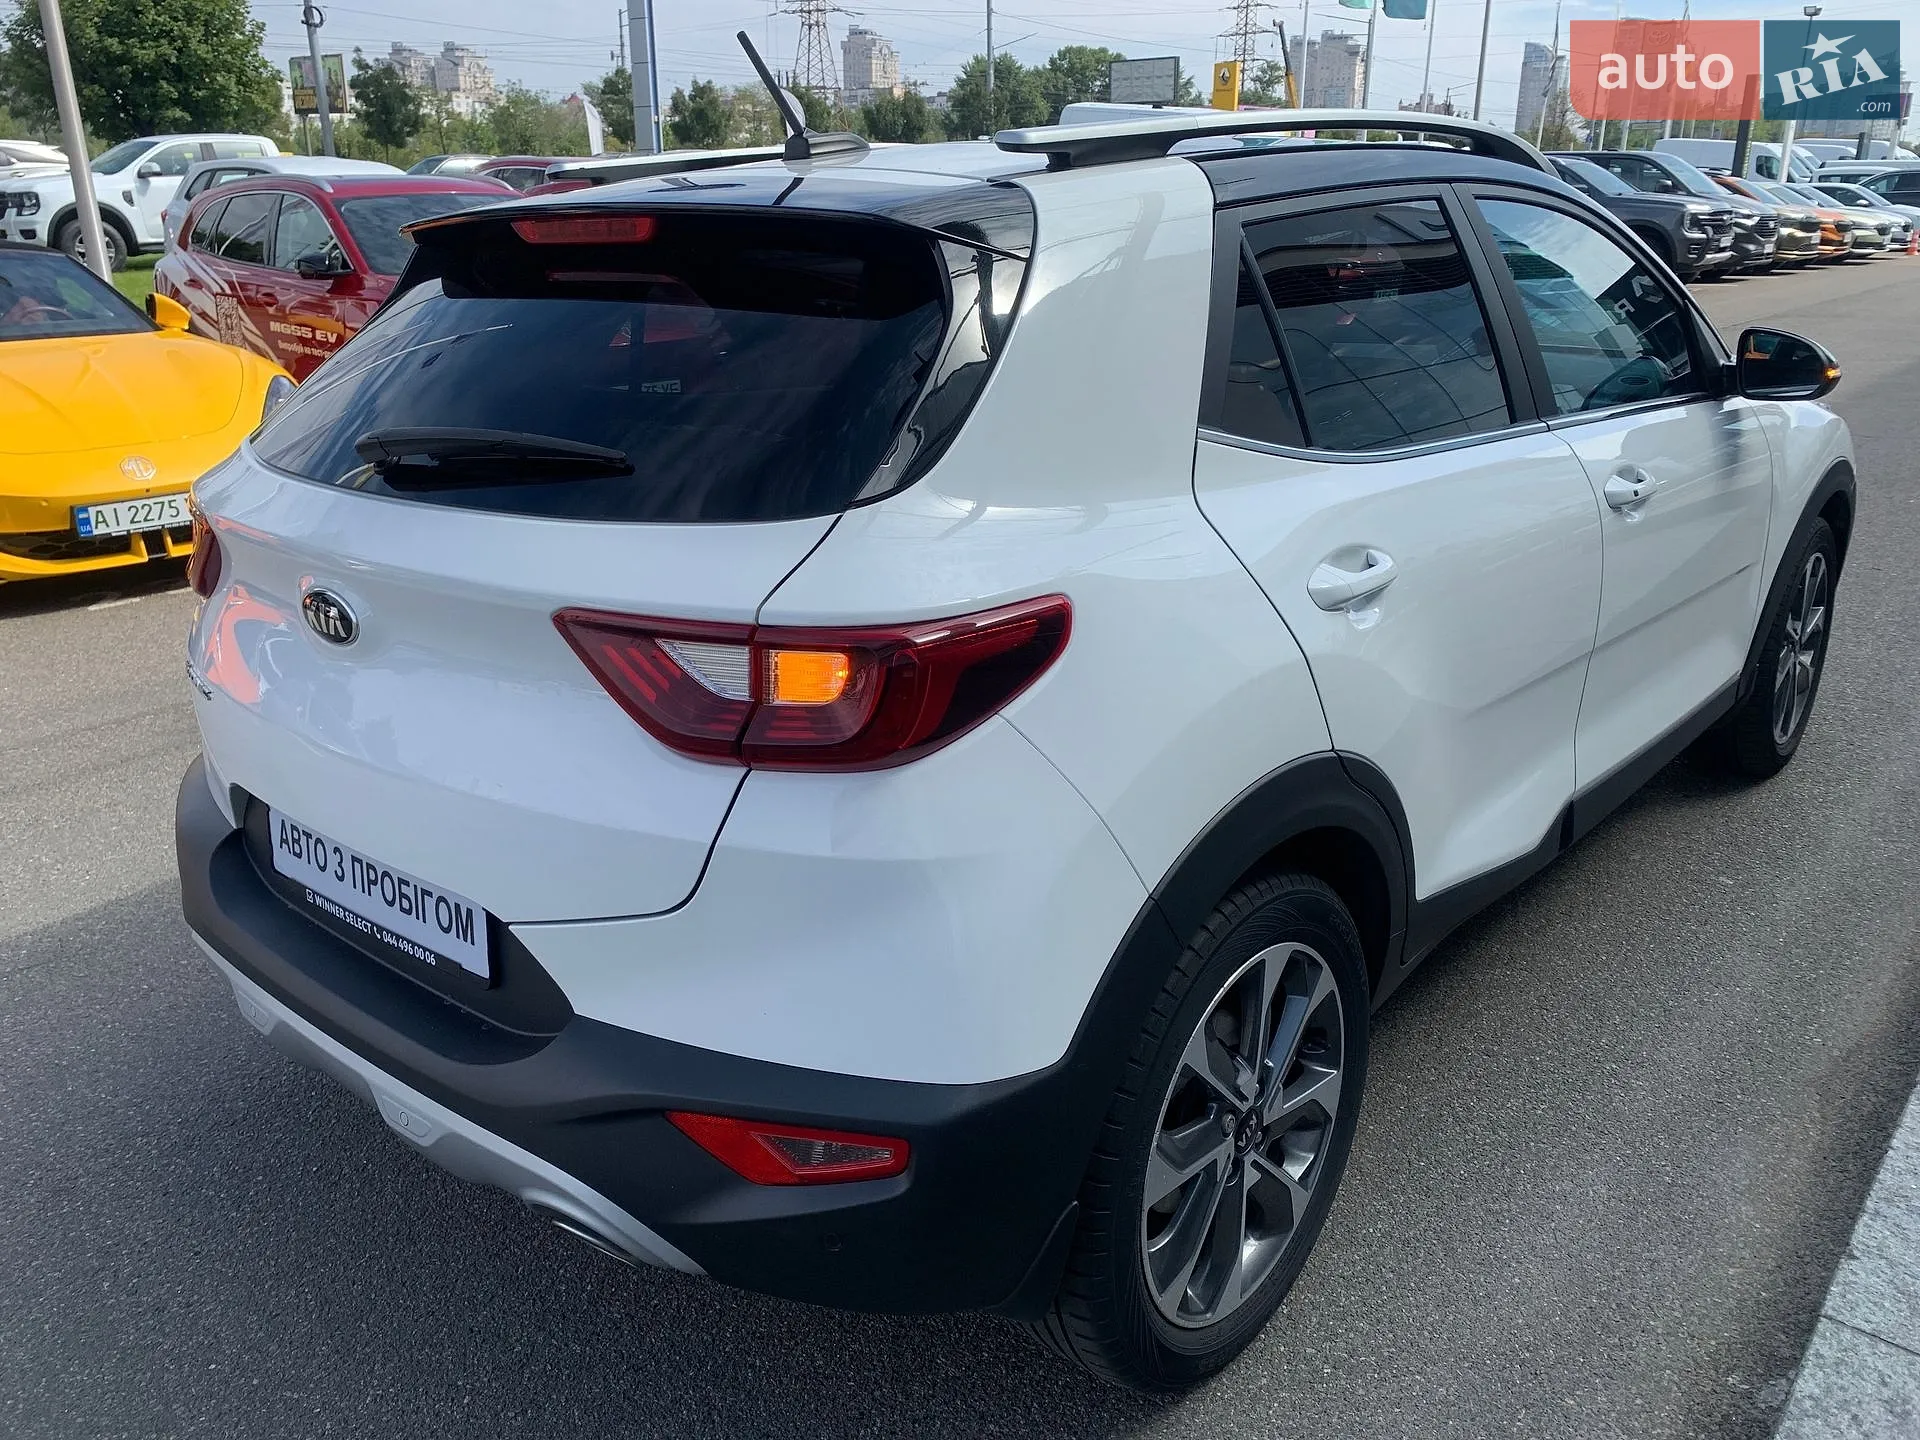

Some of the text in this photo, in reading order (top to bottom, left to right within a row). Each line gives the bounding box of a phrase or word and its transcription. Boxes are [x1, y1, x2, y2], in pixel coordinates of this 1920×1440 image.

[315, 329, 337, 344] EV
[94, 507, 120, 529] AI
[127, 499, 180, 524] 2275
[305, 597, 347, 638] KIA
[279, 819, 328, 873] АВТО
[351, 854, 475, 946] ПРОБІГОМ
[314, 894, 436, 966] WINNER SELECT 044 496 00 06
[1237, 1113, 1257, 1147] KIA
